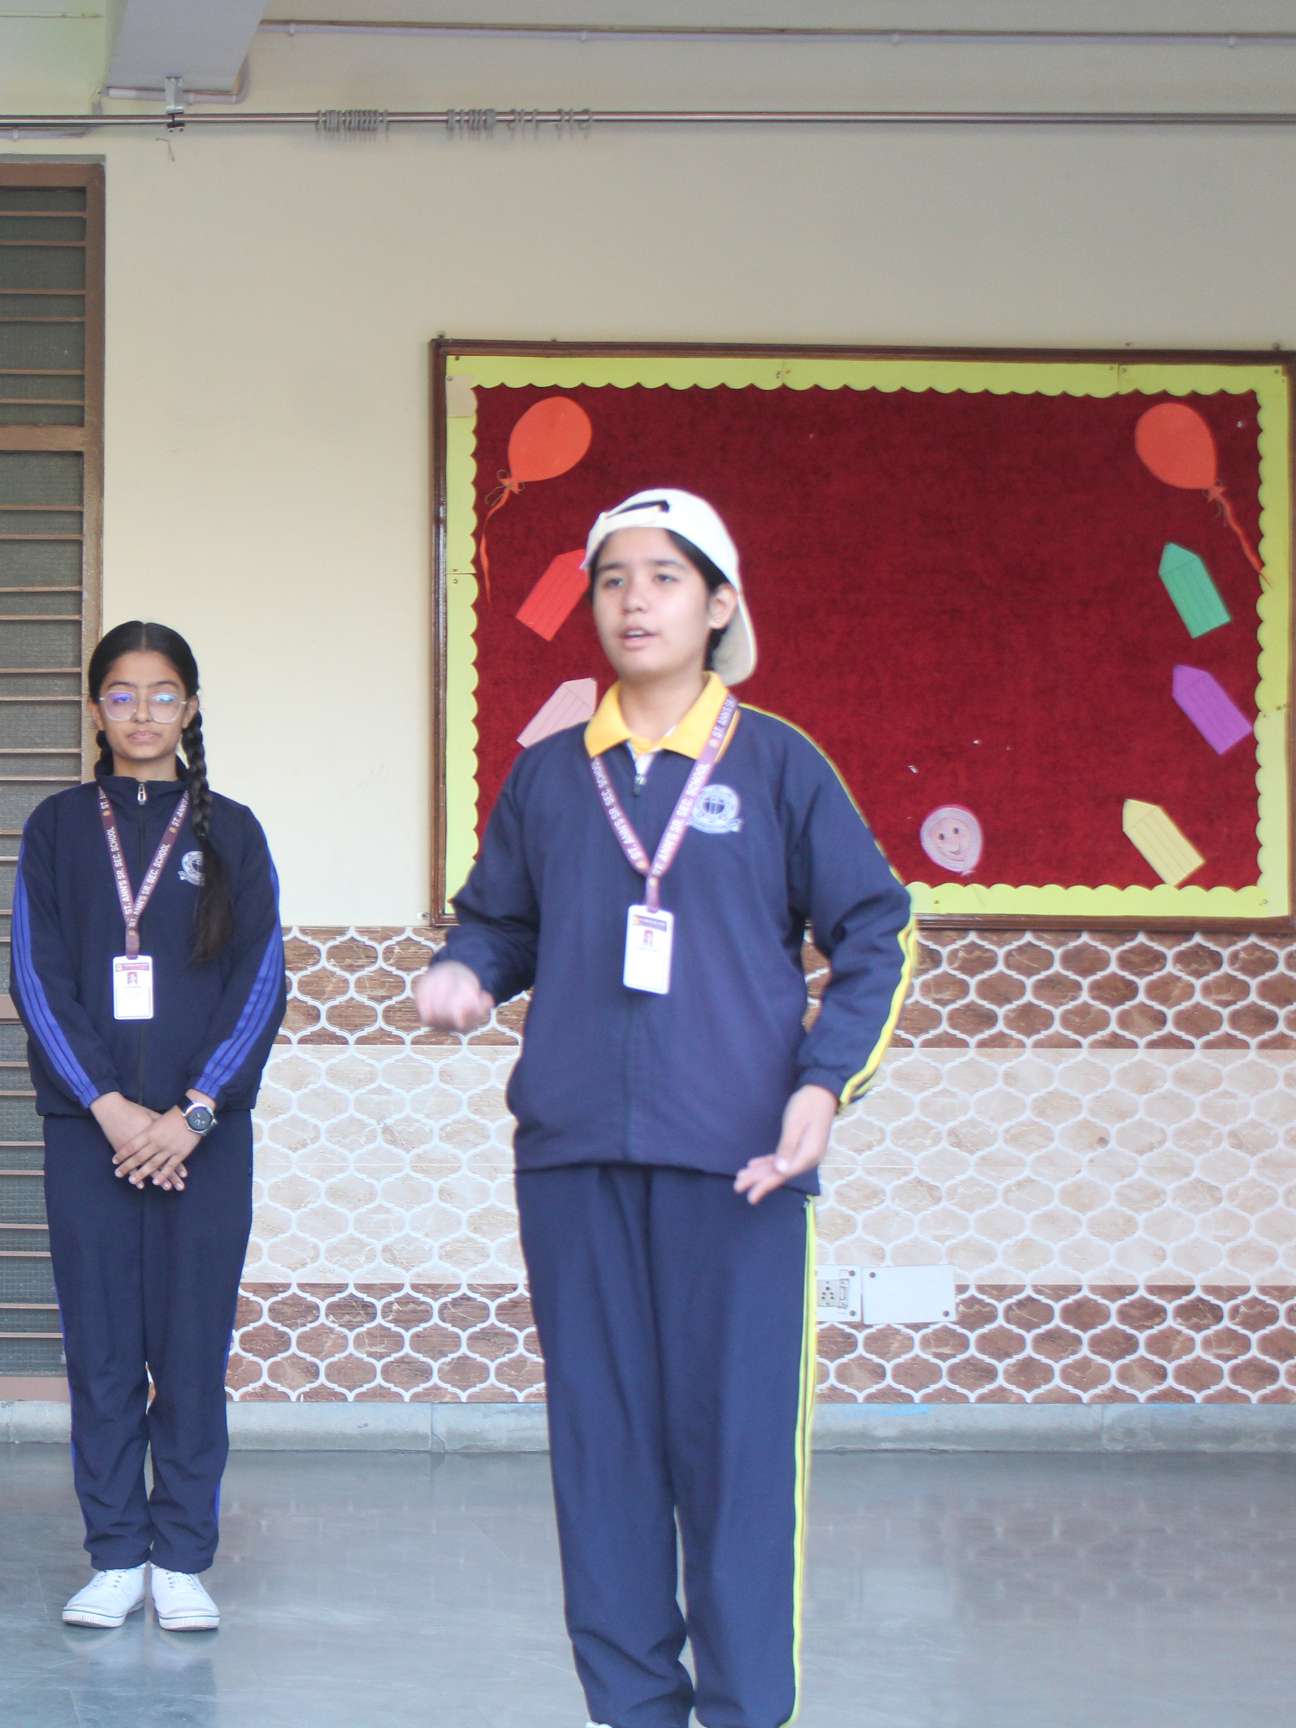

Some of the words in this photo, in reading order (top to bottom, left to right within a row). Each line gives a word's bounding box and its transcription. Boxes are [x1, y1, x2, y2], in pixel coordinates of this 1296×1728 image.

[106, 827, 117, 851] SCHOOL
[153, 843, 170, 868] SCHOOL
[118, 879, 130, 902] ANN'S
